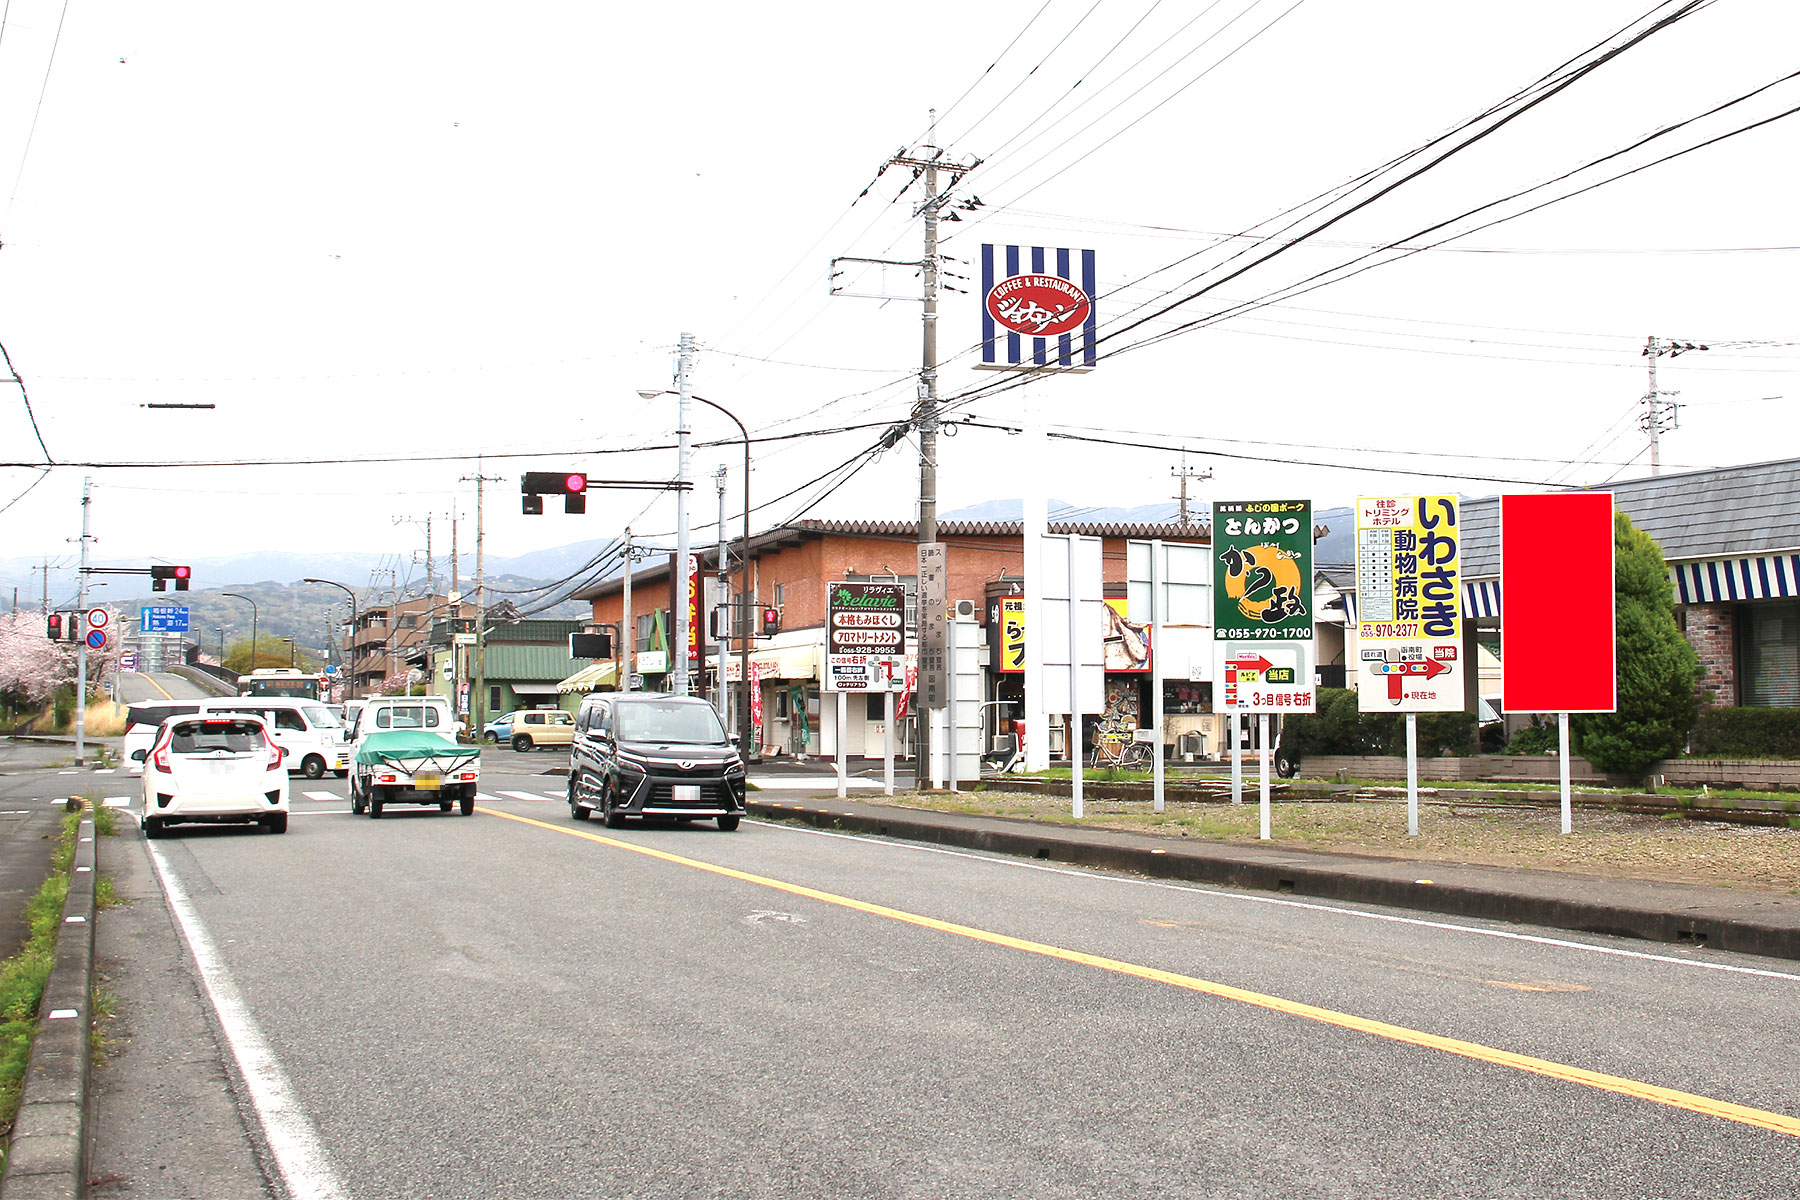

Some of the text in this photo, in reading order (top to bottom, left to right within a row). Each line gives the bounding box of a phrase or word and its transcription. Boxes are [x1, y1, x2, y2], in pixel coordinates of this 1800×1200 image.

[993, 276, 1085, 303] COFFEE & RESTAURANT
[1376, 500, 1397, 509] 往診
[1365, 508, 1410, 517] トリミング
[1373, 517, 1401, 526] ホテル
[1225, 517, 1300, 537] とんかつ
[1418, 497, 1458, 637] いわさき
[1394, 529, 1419, 620] 動物病院
[863, 586, 894, 594] リラヴィエ
[1005, 602, 1024, 610] 元祖
[92, 614, 104, 623] 40
[838, 614, 897, 626] 本格もみほぐし
[1228, 628, 1311, 638] 055-970-1700
[1361, 624, 1418, 637] 055-970-2377
[838, 632, 897, 643] アロマトリートメント
[1435, 647, 1456, 658] 当院
[831, 655, 867, 665] この信号右折
[1268, 669, 1290, 680] 当店
[1411, 691, 1437, 700] 現在地
